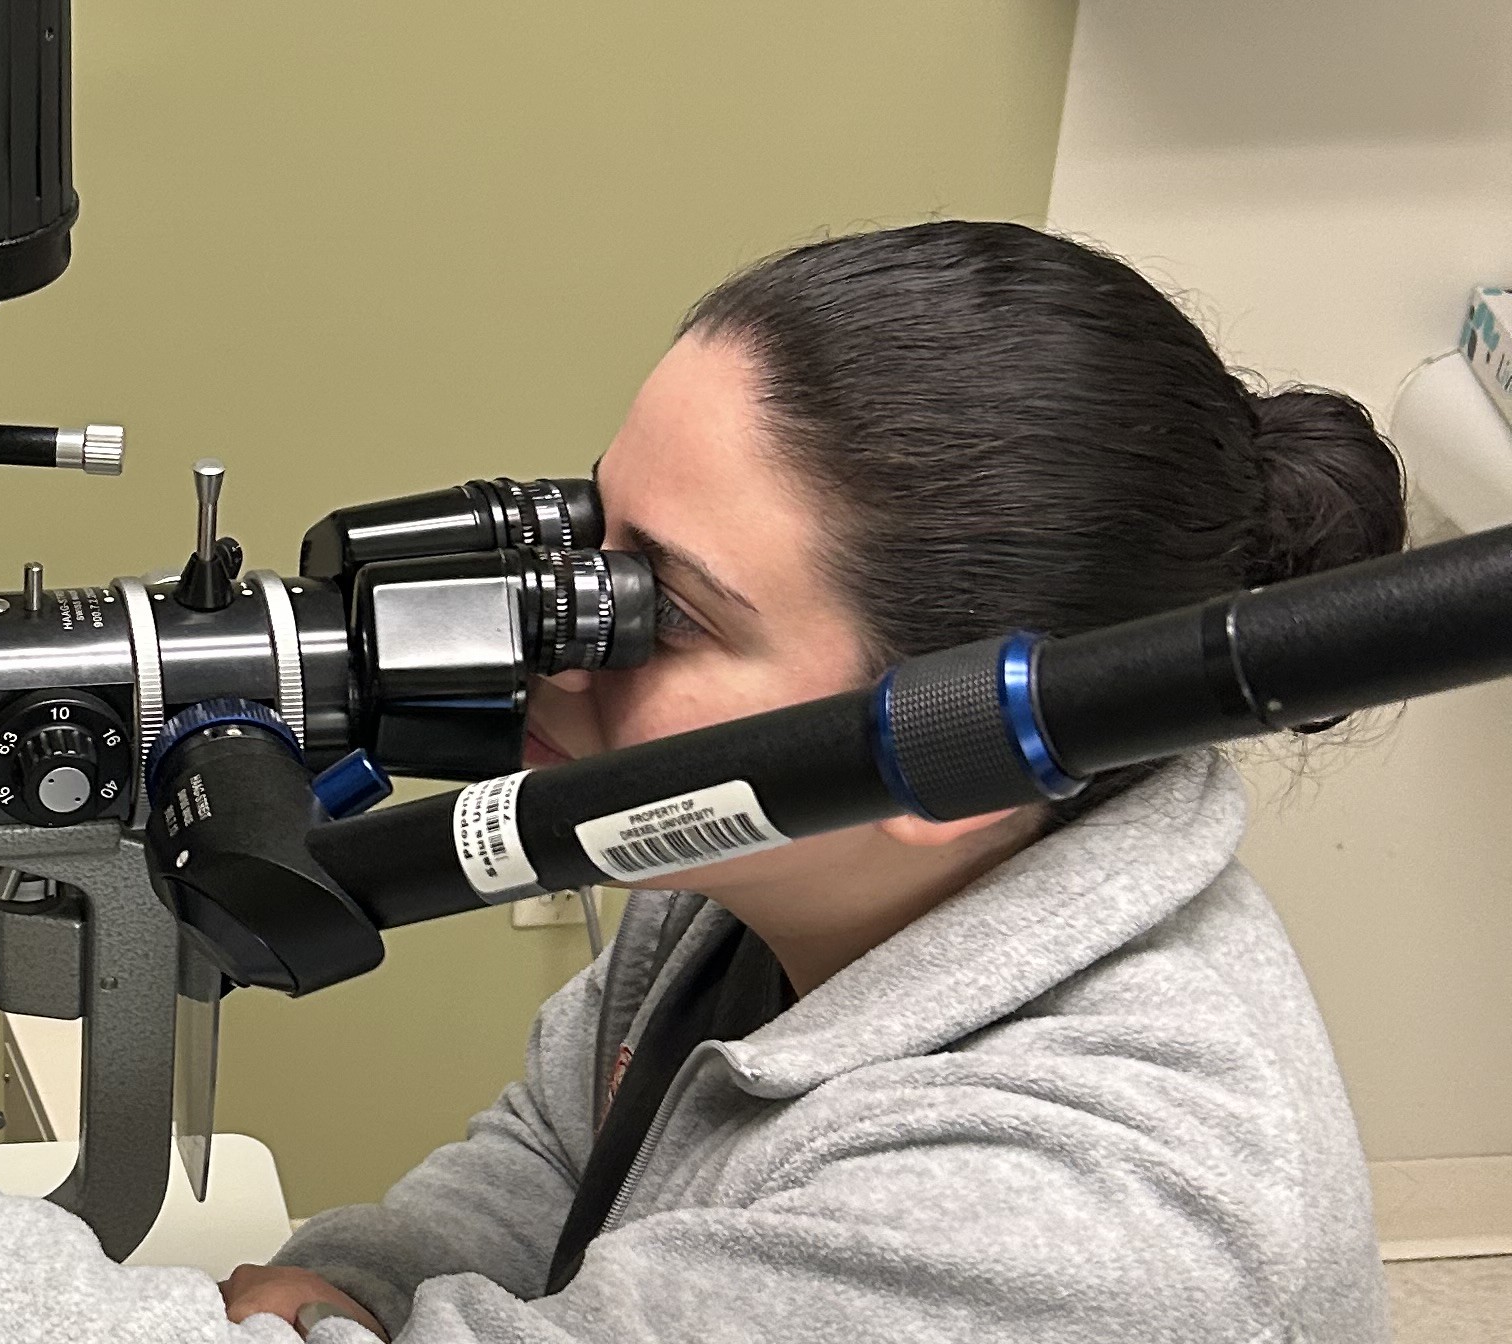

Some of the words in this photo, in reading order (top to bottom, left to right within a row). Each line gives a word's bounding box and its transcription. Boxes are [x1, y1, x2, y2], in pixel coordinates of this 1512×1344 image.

[50, 707, 70, 720] 10
[103, 728, 121, 747] 16
[100, 780, 118, 799] 40
[628, 803, 681, 825] PROPERTY
[681, 798, 695, 811] OF
[657, 806, 716, 830] UNIVERSITY
[461, 790, 474, 859] Property
[475, 829, 498, 878] Salus
